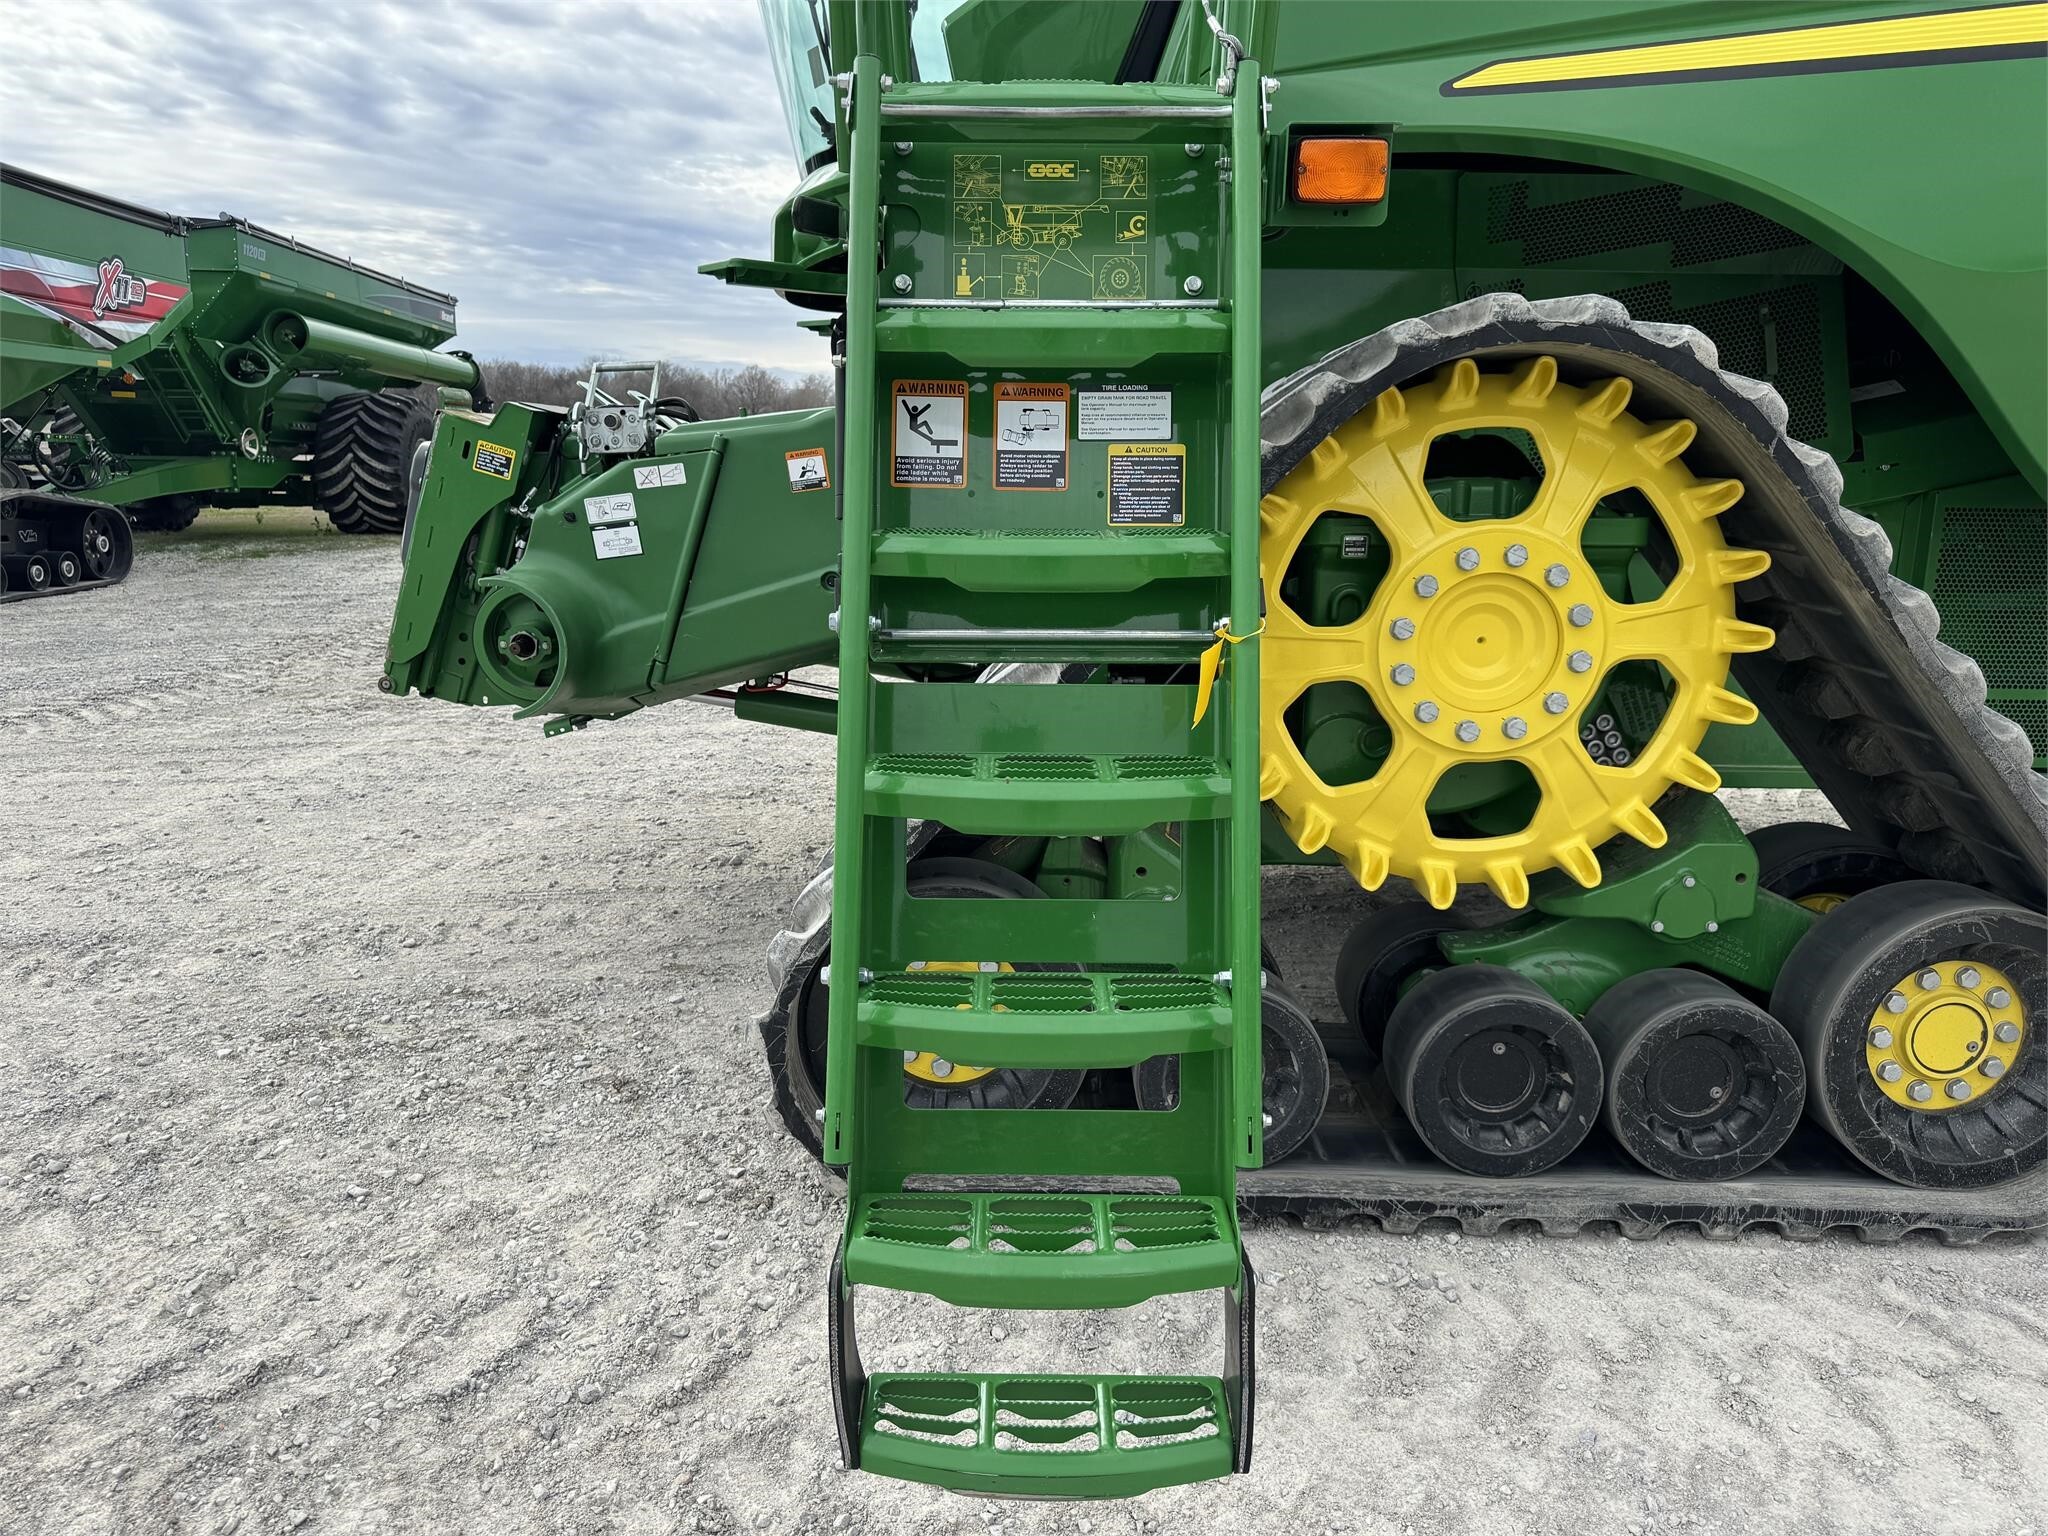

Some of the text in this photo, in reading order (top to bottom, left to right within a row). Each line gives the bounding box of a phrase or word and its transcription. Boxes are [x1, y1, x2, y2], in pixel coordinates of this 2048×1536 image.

[908, 383, 965, 395] WARNING
[1013, 387, 1064, 397] WARNING
[485, 443, 514, 456] CAUTION
